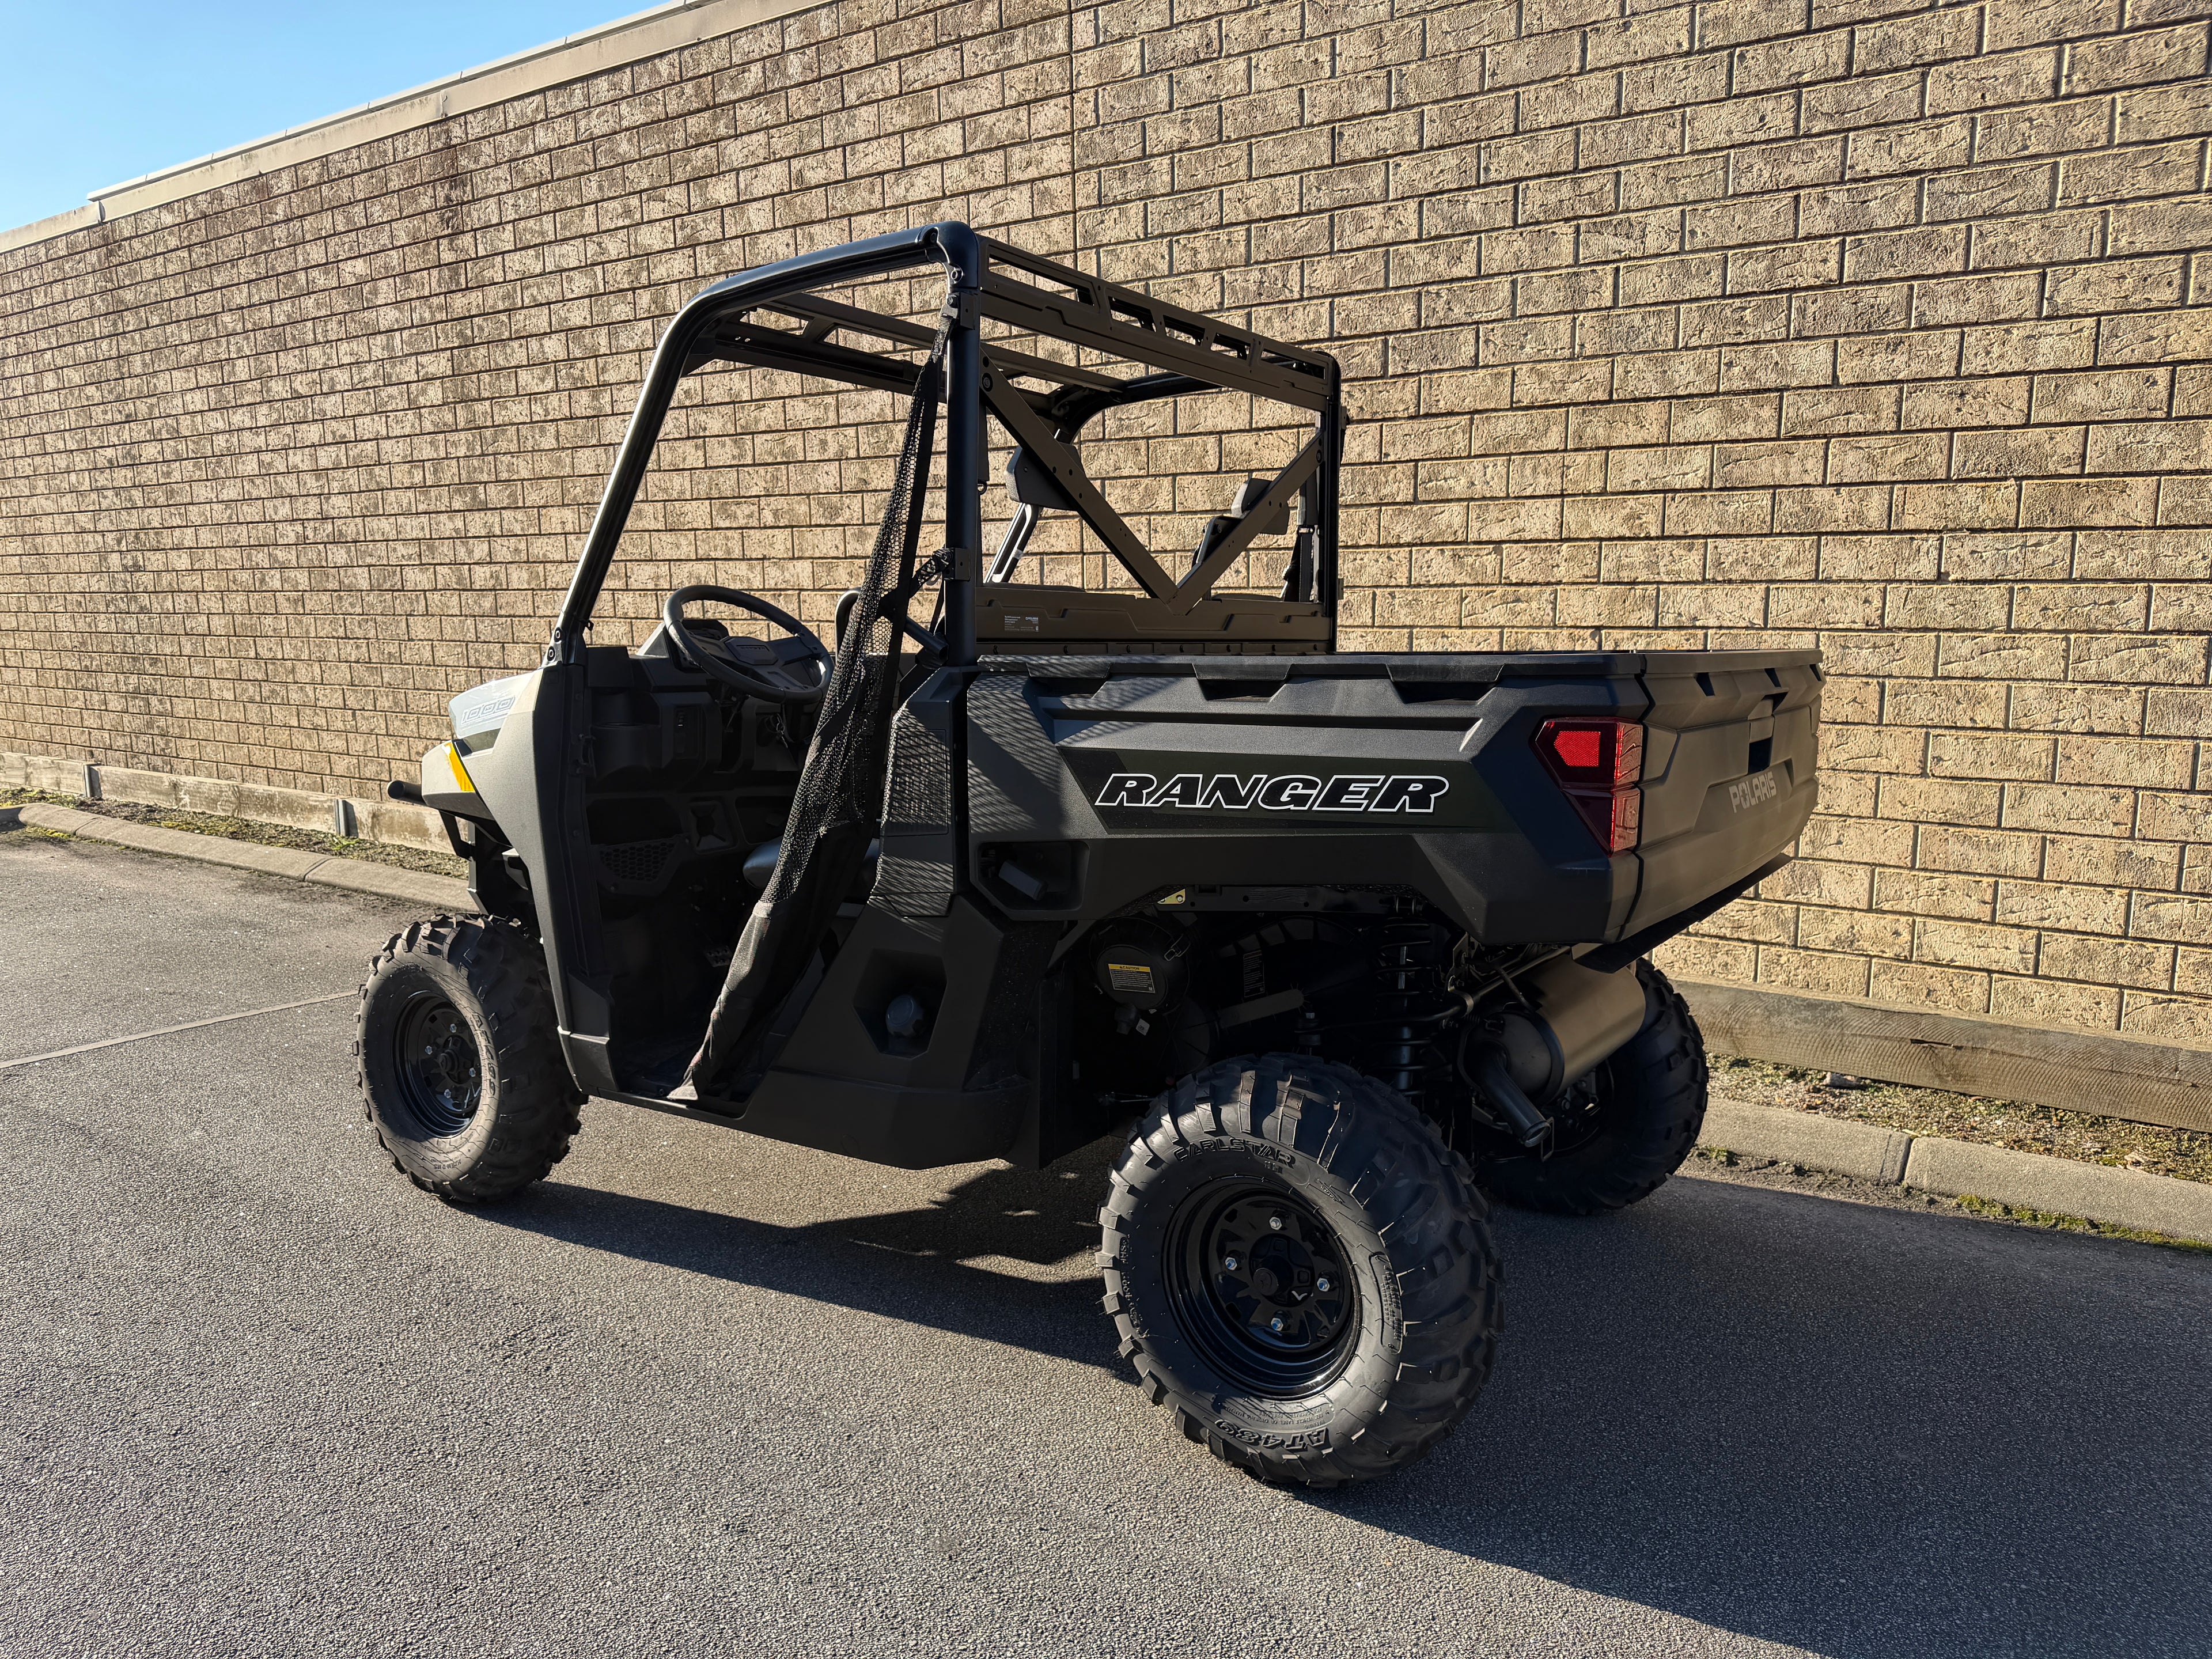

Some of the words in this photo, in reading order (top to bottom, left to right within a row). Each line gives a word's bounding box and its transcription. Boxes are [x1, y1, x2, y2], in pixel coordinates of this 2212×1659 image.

[461, 695, 516, 725] 1000
[1094, 772, 1450, 813] RANGER
[1728, 771, 1777, 813] POLARIS
[1173, 1137, 1295, 1168] CARLSTAR
[1214, 1419, 1327, 1450] AT489
